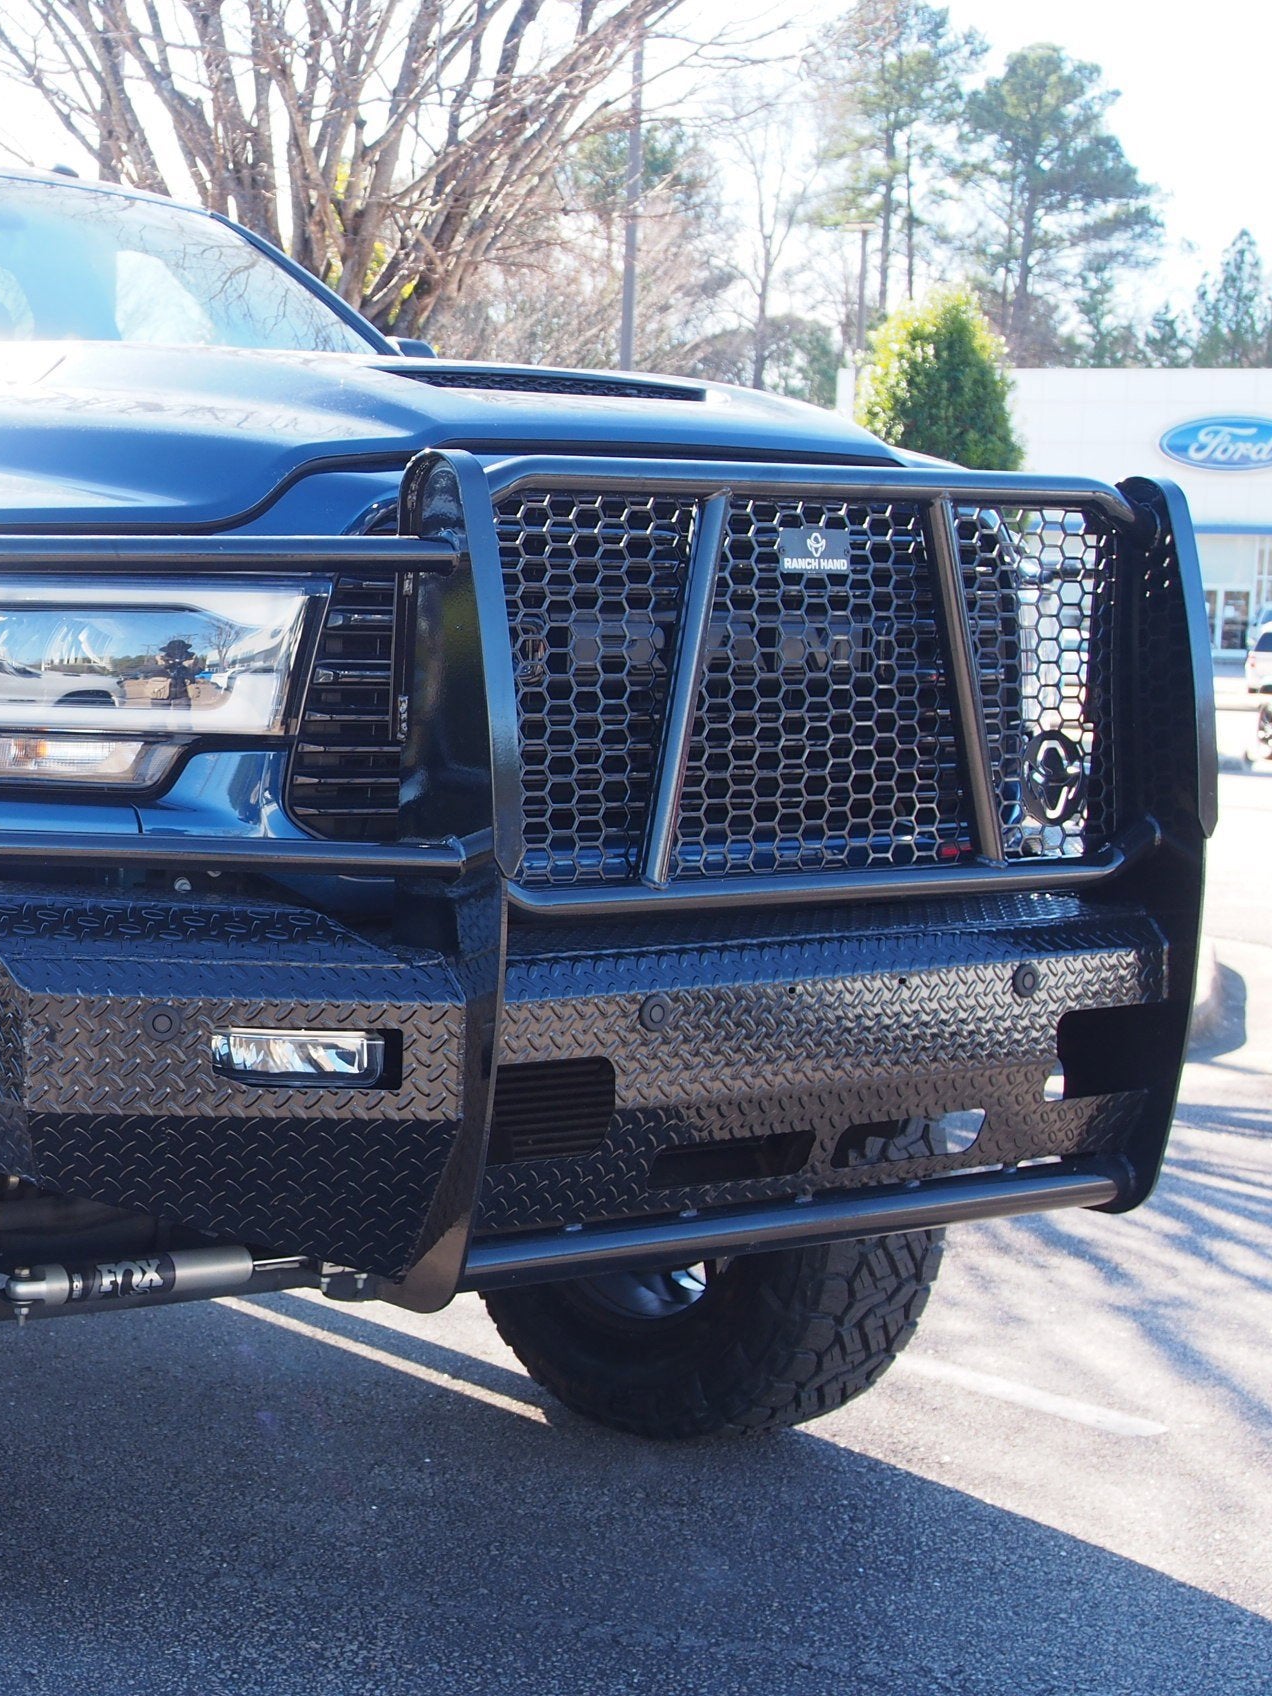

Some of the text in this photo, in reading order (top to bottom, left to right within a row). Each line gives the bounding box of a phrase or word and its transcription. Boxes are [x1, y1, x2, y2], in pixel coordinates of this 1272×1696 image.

[1188, 425, 1272, 461] Ford
[783, 557, 848, 570] RANCH HAND
[96, 1259, 164, 1297] FOX
